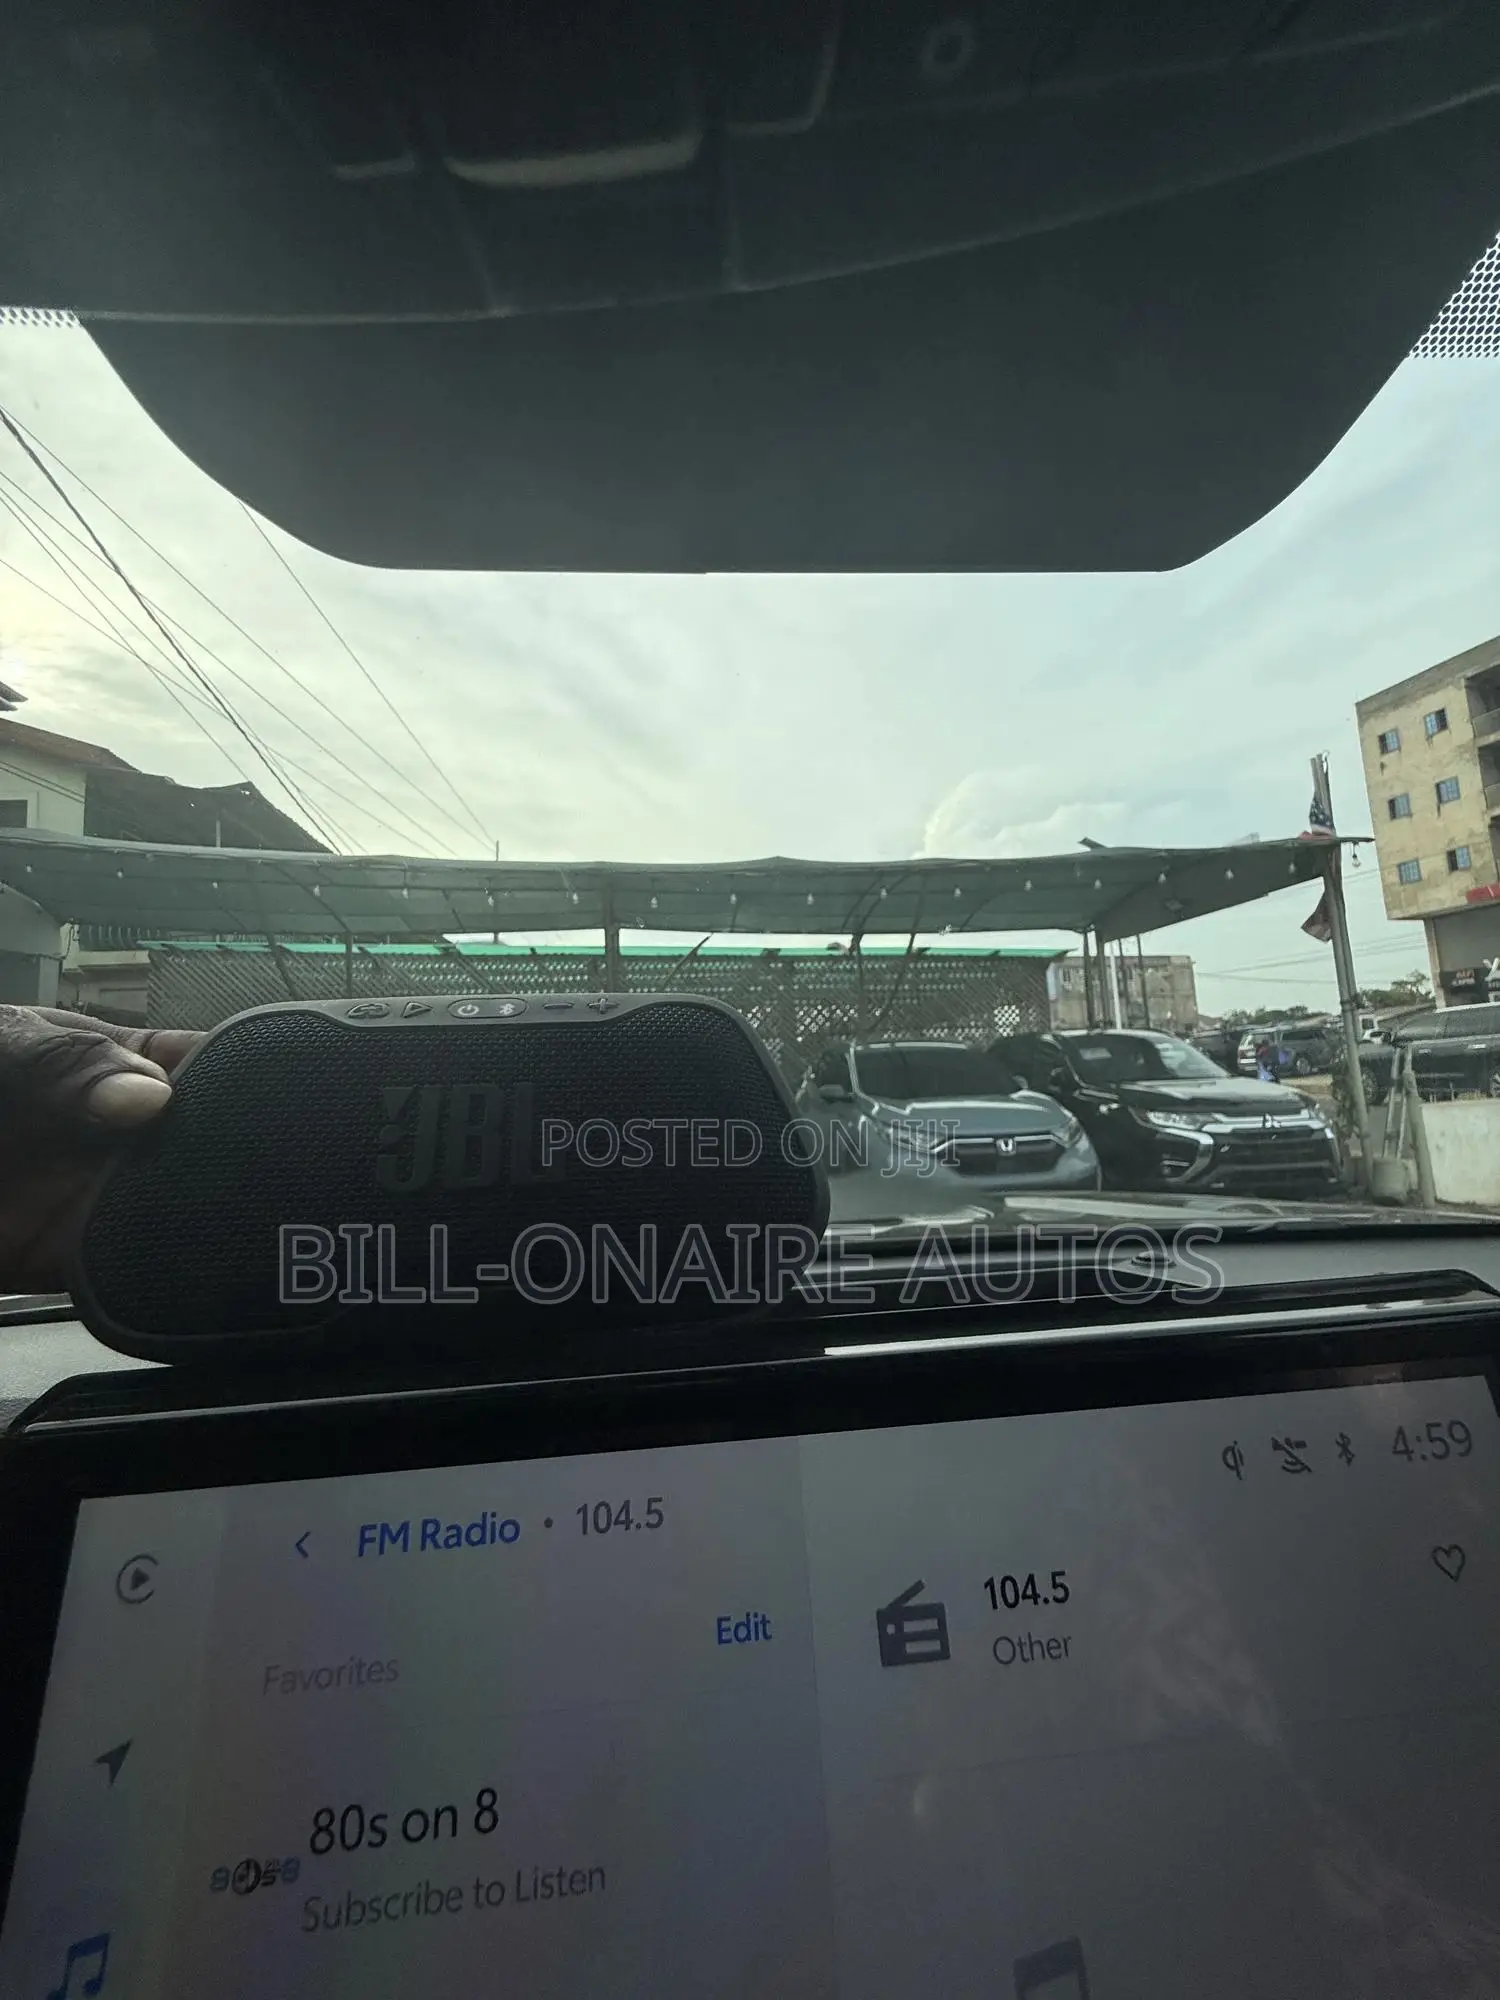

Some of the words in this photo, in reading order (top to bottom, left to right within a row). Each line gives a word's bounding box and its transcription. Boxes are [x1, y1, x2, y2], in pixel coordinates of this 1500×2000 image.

[374, 1083, 567, 1190] JBL
[1391, 1419, 1474, 1462] 4:59
[357, 1519, 410, 1558] FM
[420, 1511, 521, 1551] Radio
[575, 1496, 665, 1536] 104.5
[984, 1570, 1070, 1610] 104.5
[716, 1612, 773, 1645] Edit
[992, 1631, 1072, 1666] Other
[262, 1655, 400, 1696] Favorites
[309, 1803, 389, 1856] 80s
[401, 1804, 460, 1844] on
[473, 1786, 500, 1835] 8
[300, 1878, 464, 1934] Subscribe
[471, 1875, 506, 1910] to
[514, 1863, 607, 1904] Listen
